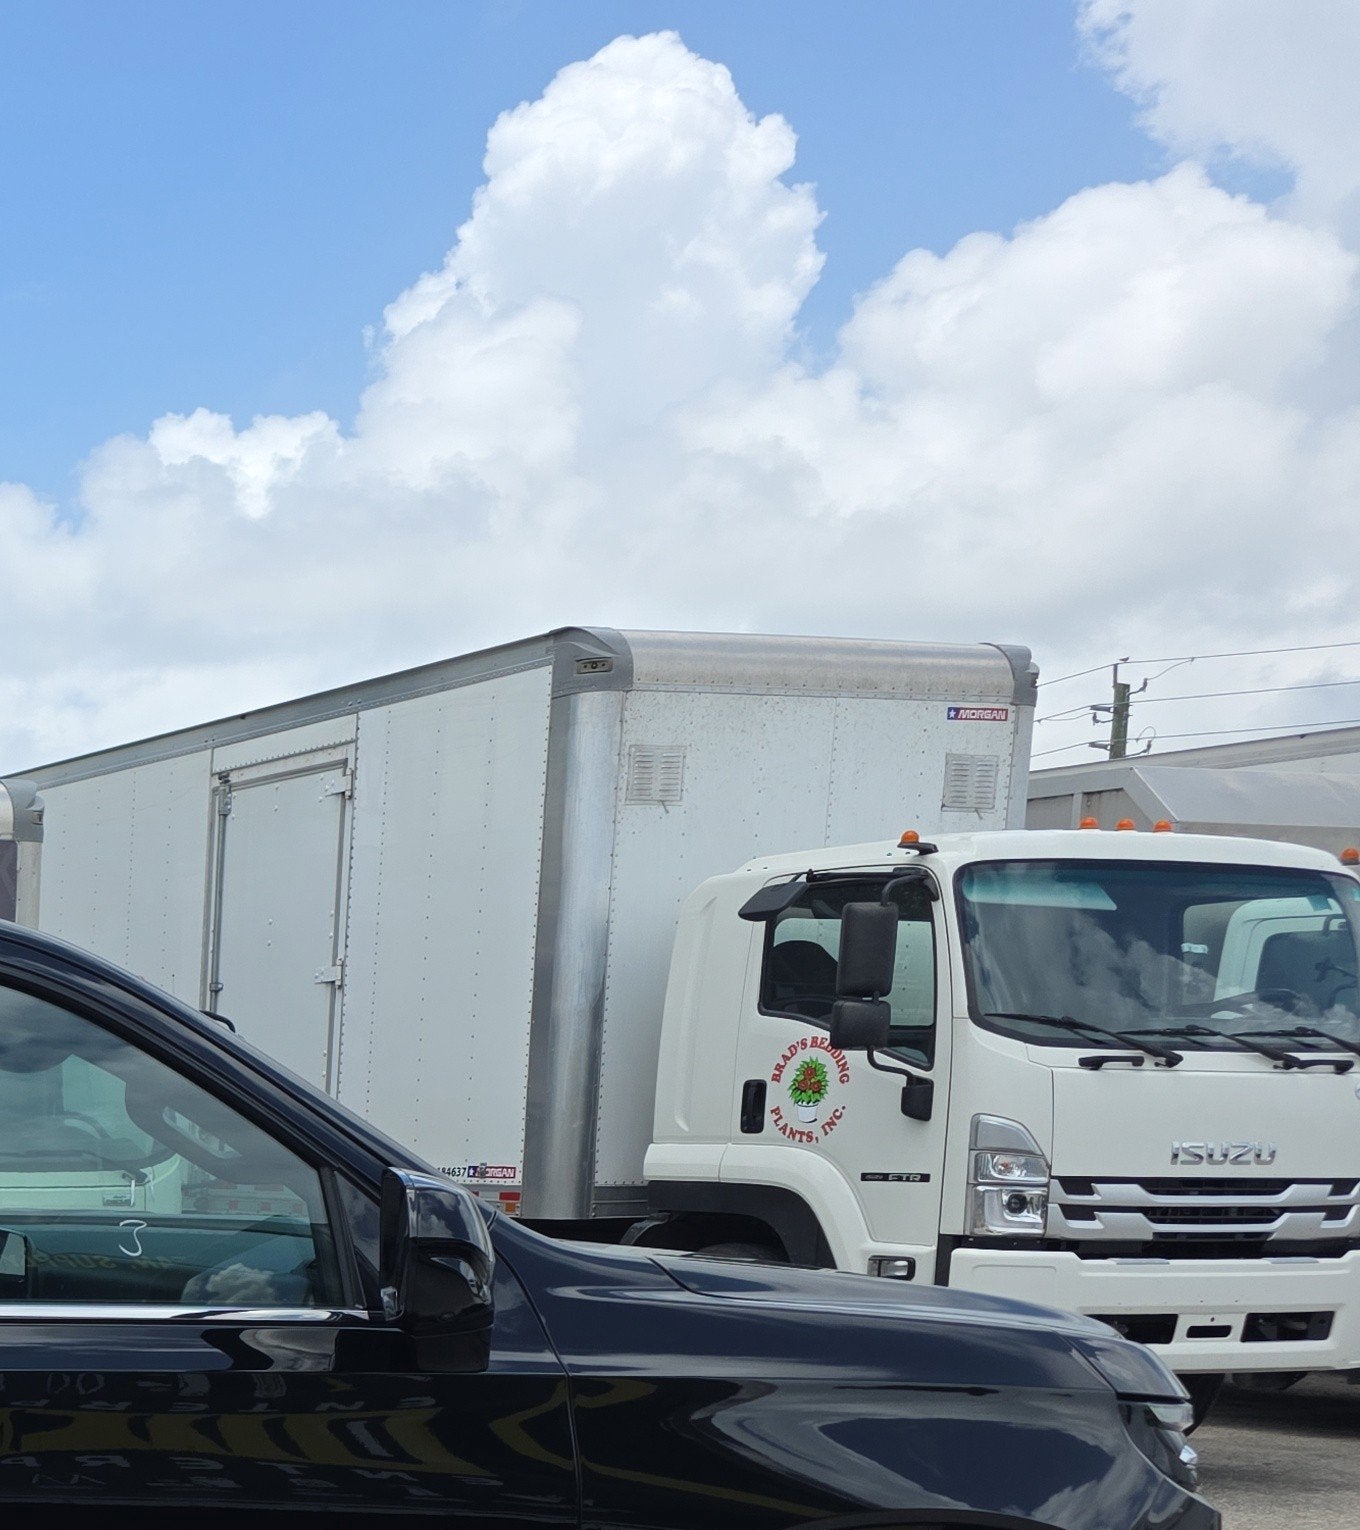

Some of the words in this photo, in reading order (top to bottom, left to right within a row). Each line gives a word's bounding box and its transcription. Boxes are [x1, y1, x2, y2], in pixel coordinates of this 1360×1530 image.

[958, 709, 1006, 720] MORGAN
[771, 1037, 808, 1083] BRAD'S
[770, 1106, 819, 1143] PLANTS,
[821, 1105, 846, 1136] INC.
[1170, 1141, 1277, 1166] ISUZU
